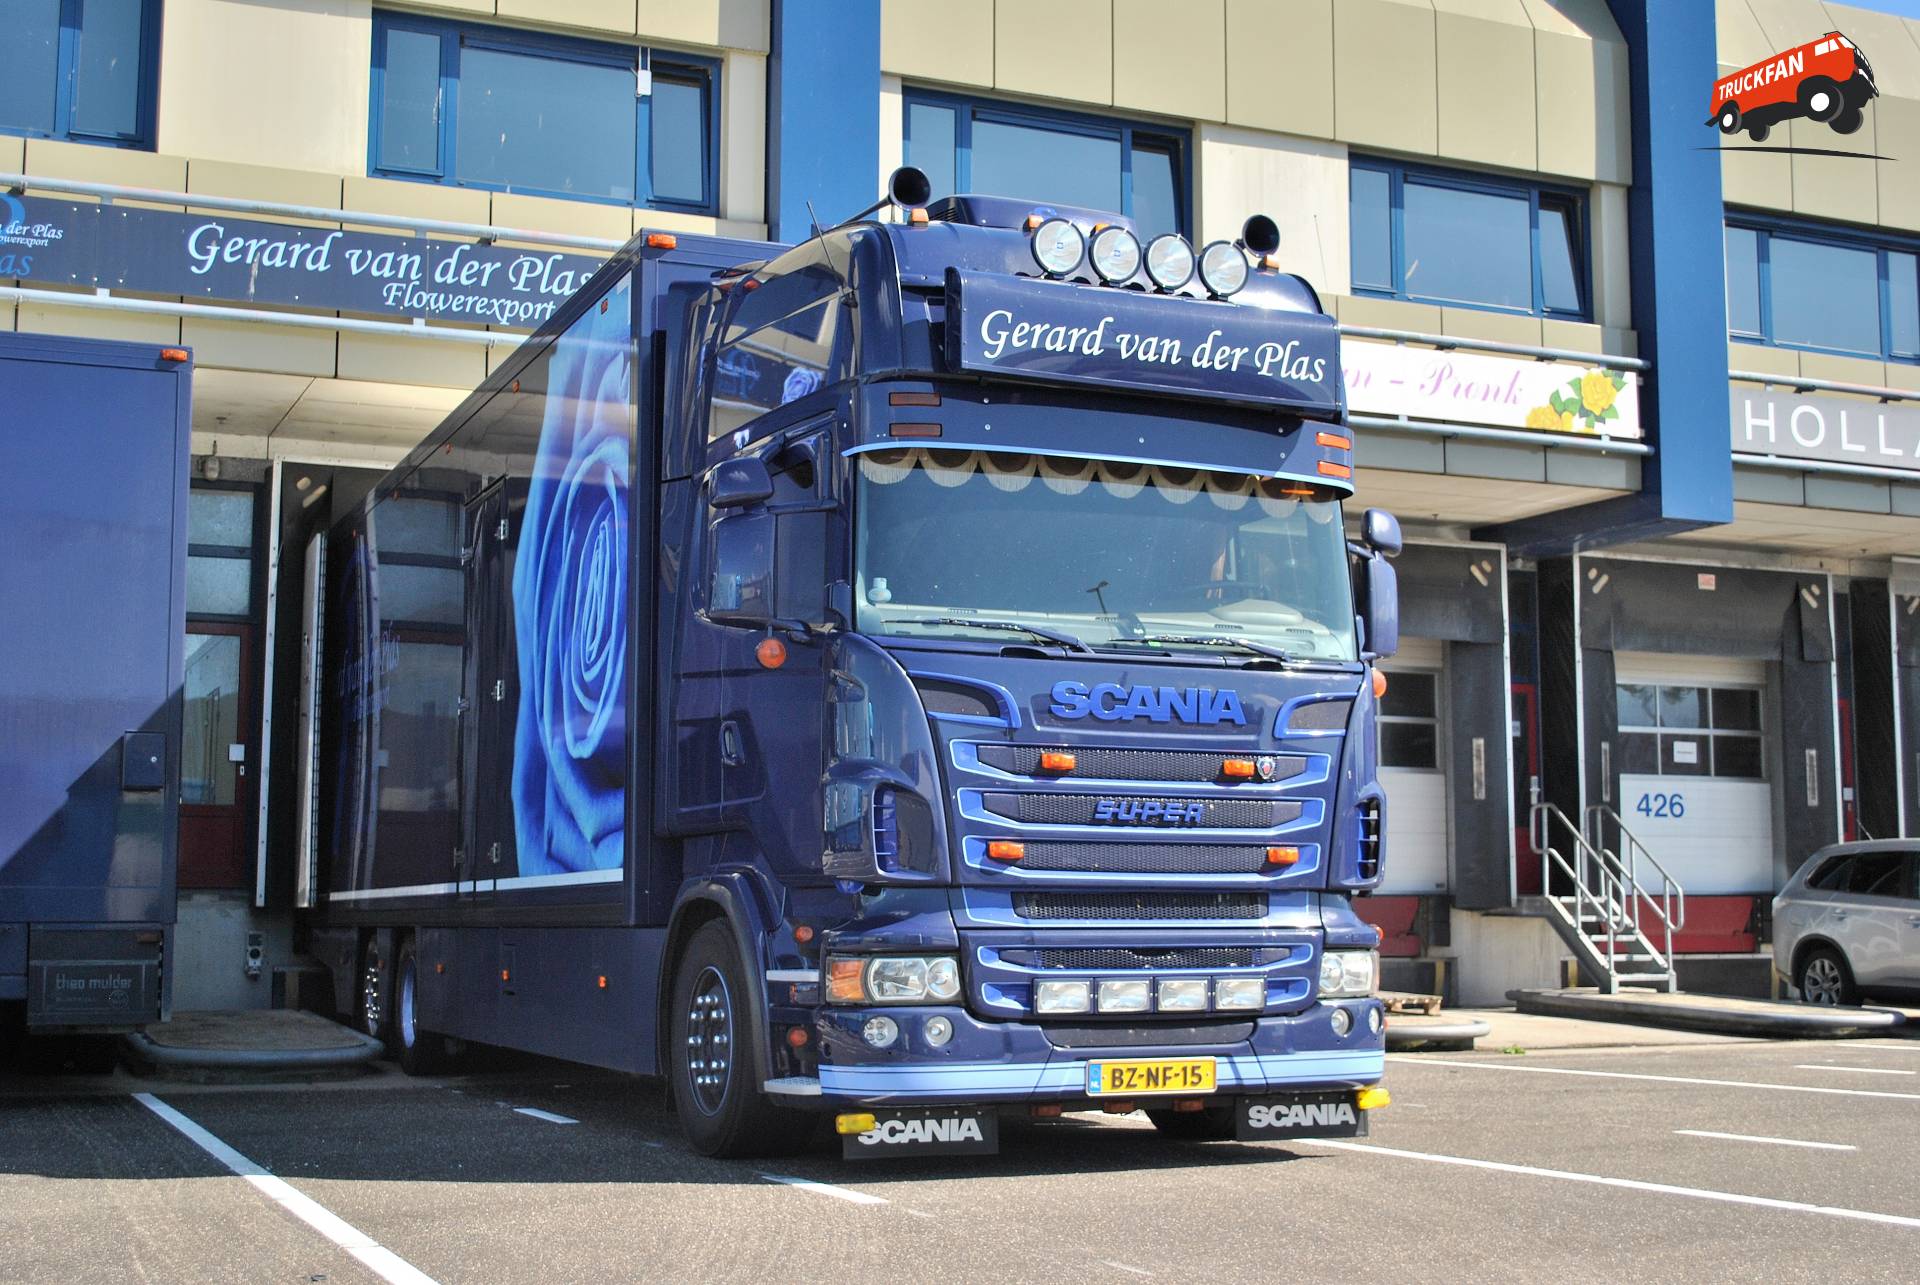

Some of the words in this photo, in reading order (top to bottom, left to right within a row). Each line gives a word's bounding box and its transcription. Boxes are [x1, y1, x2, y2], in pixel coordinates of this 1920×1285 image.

[6, 220, 30, 236] der
[32, 223, 64, 240] Plas
[188, 223, 343, 275] Gerard
[345, 249, 423, 281] van
[434, 245, 501, 287] der
[382, 281, 556, 326] Flowerexport
[980, 310, 1114, 359] Gerard
[1116, 332, 1182, 364] van
[1191, 330, 1250, 372] der
[1254, 340, 1326, 383] Plas
[1419, 360, 1523, 405] Pronk
[1745, 399, 1920, 458] HOLL
[1050, 680, 1247, 725] SCANIA
[1094, 800, 1205, 823] SUPER
[1637, 793, 1685, 818] 426
[56, 973, 85, 990] theo
[89, 974, 132, 990] mulder
[1111, 1065, 1203, 1090] BZ-NF-15
[1248, 1103, 1357, 1129] SCANIA
[858, 1118, 984, 1145] SCANIA
